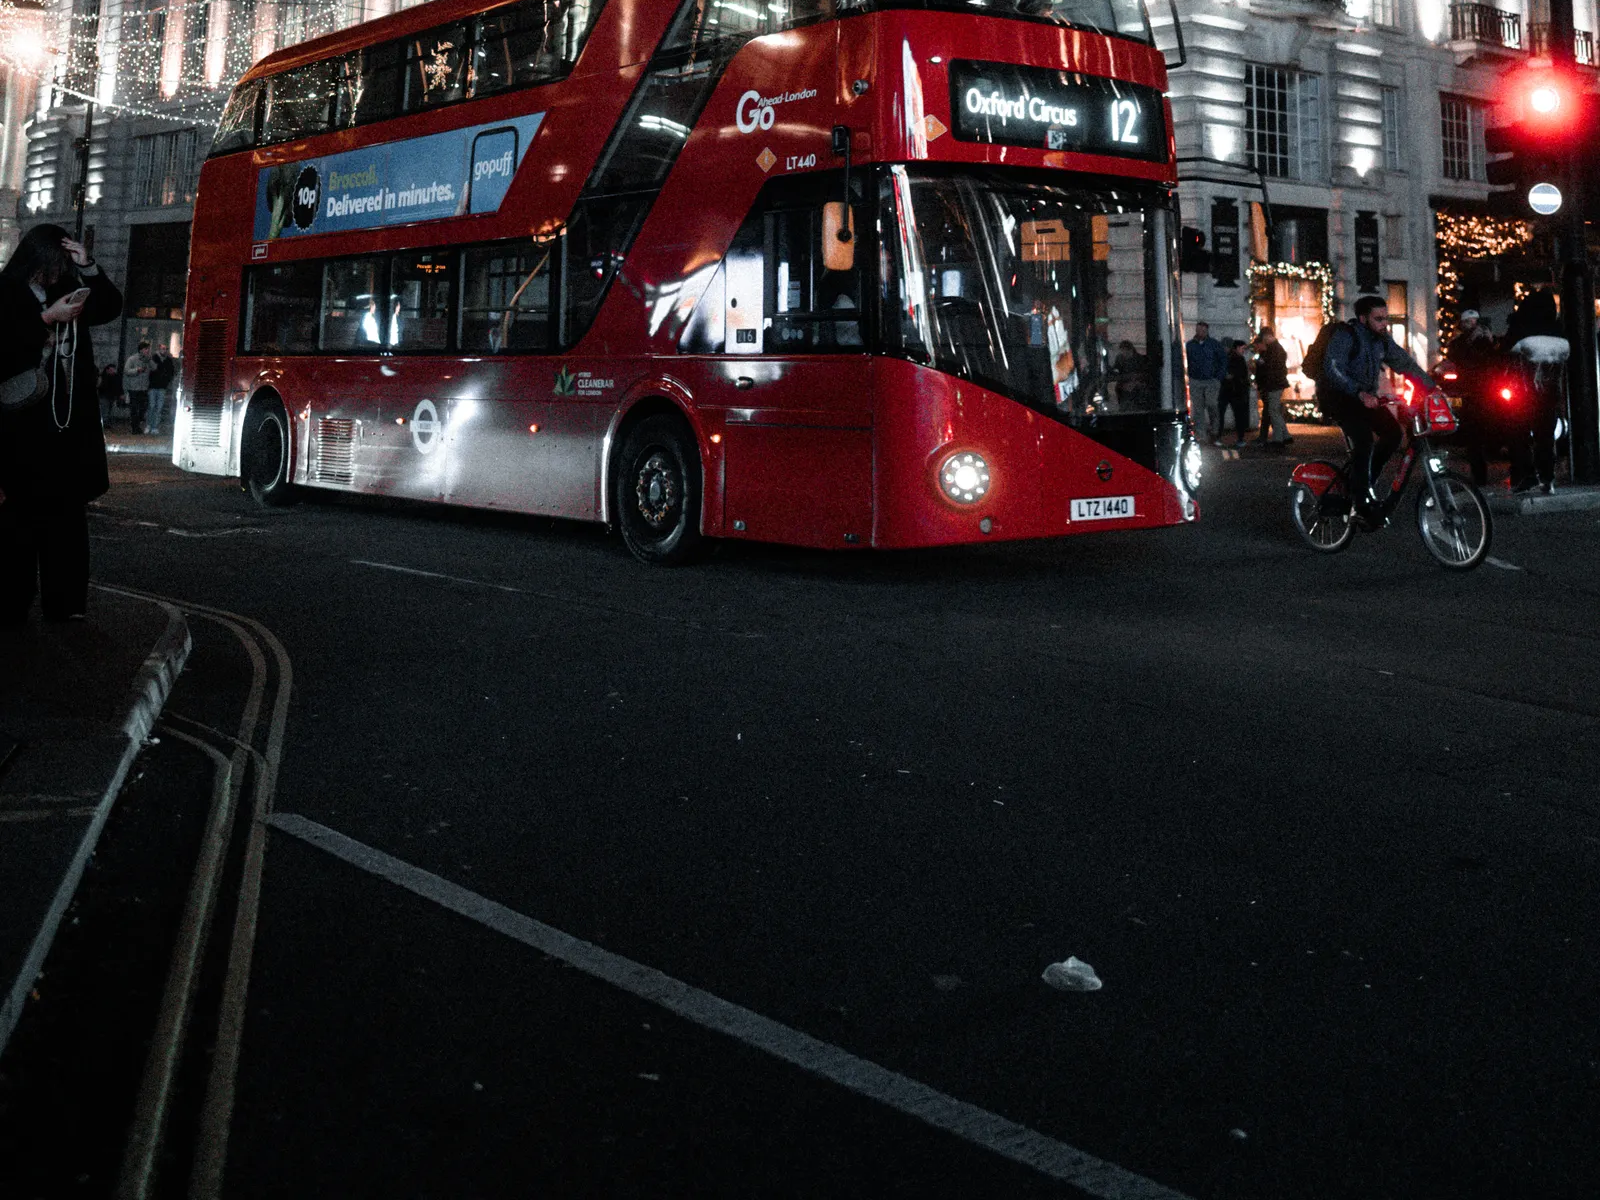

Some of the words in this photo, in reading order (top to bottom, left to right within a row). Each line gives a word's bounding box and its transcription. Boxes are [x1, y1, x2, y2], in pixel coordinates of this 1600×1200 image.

[736, 89, 775, 134] Go
[966, 87, 1024, 120] Oxford
[1028, 97, 1077, 127] Circus
[1111, 99, 1139, 144] 12
[474, 150, 513, 181] gopuff
[786, 153, 816, 170] LT440
[298, 188, 316, 209] 10p
[326, 188, 383, 218] Delivered
[384, 187, 396, 209] in
[397, 180, 455, 208] minutes.
